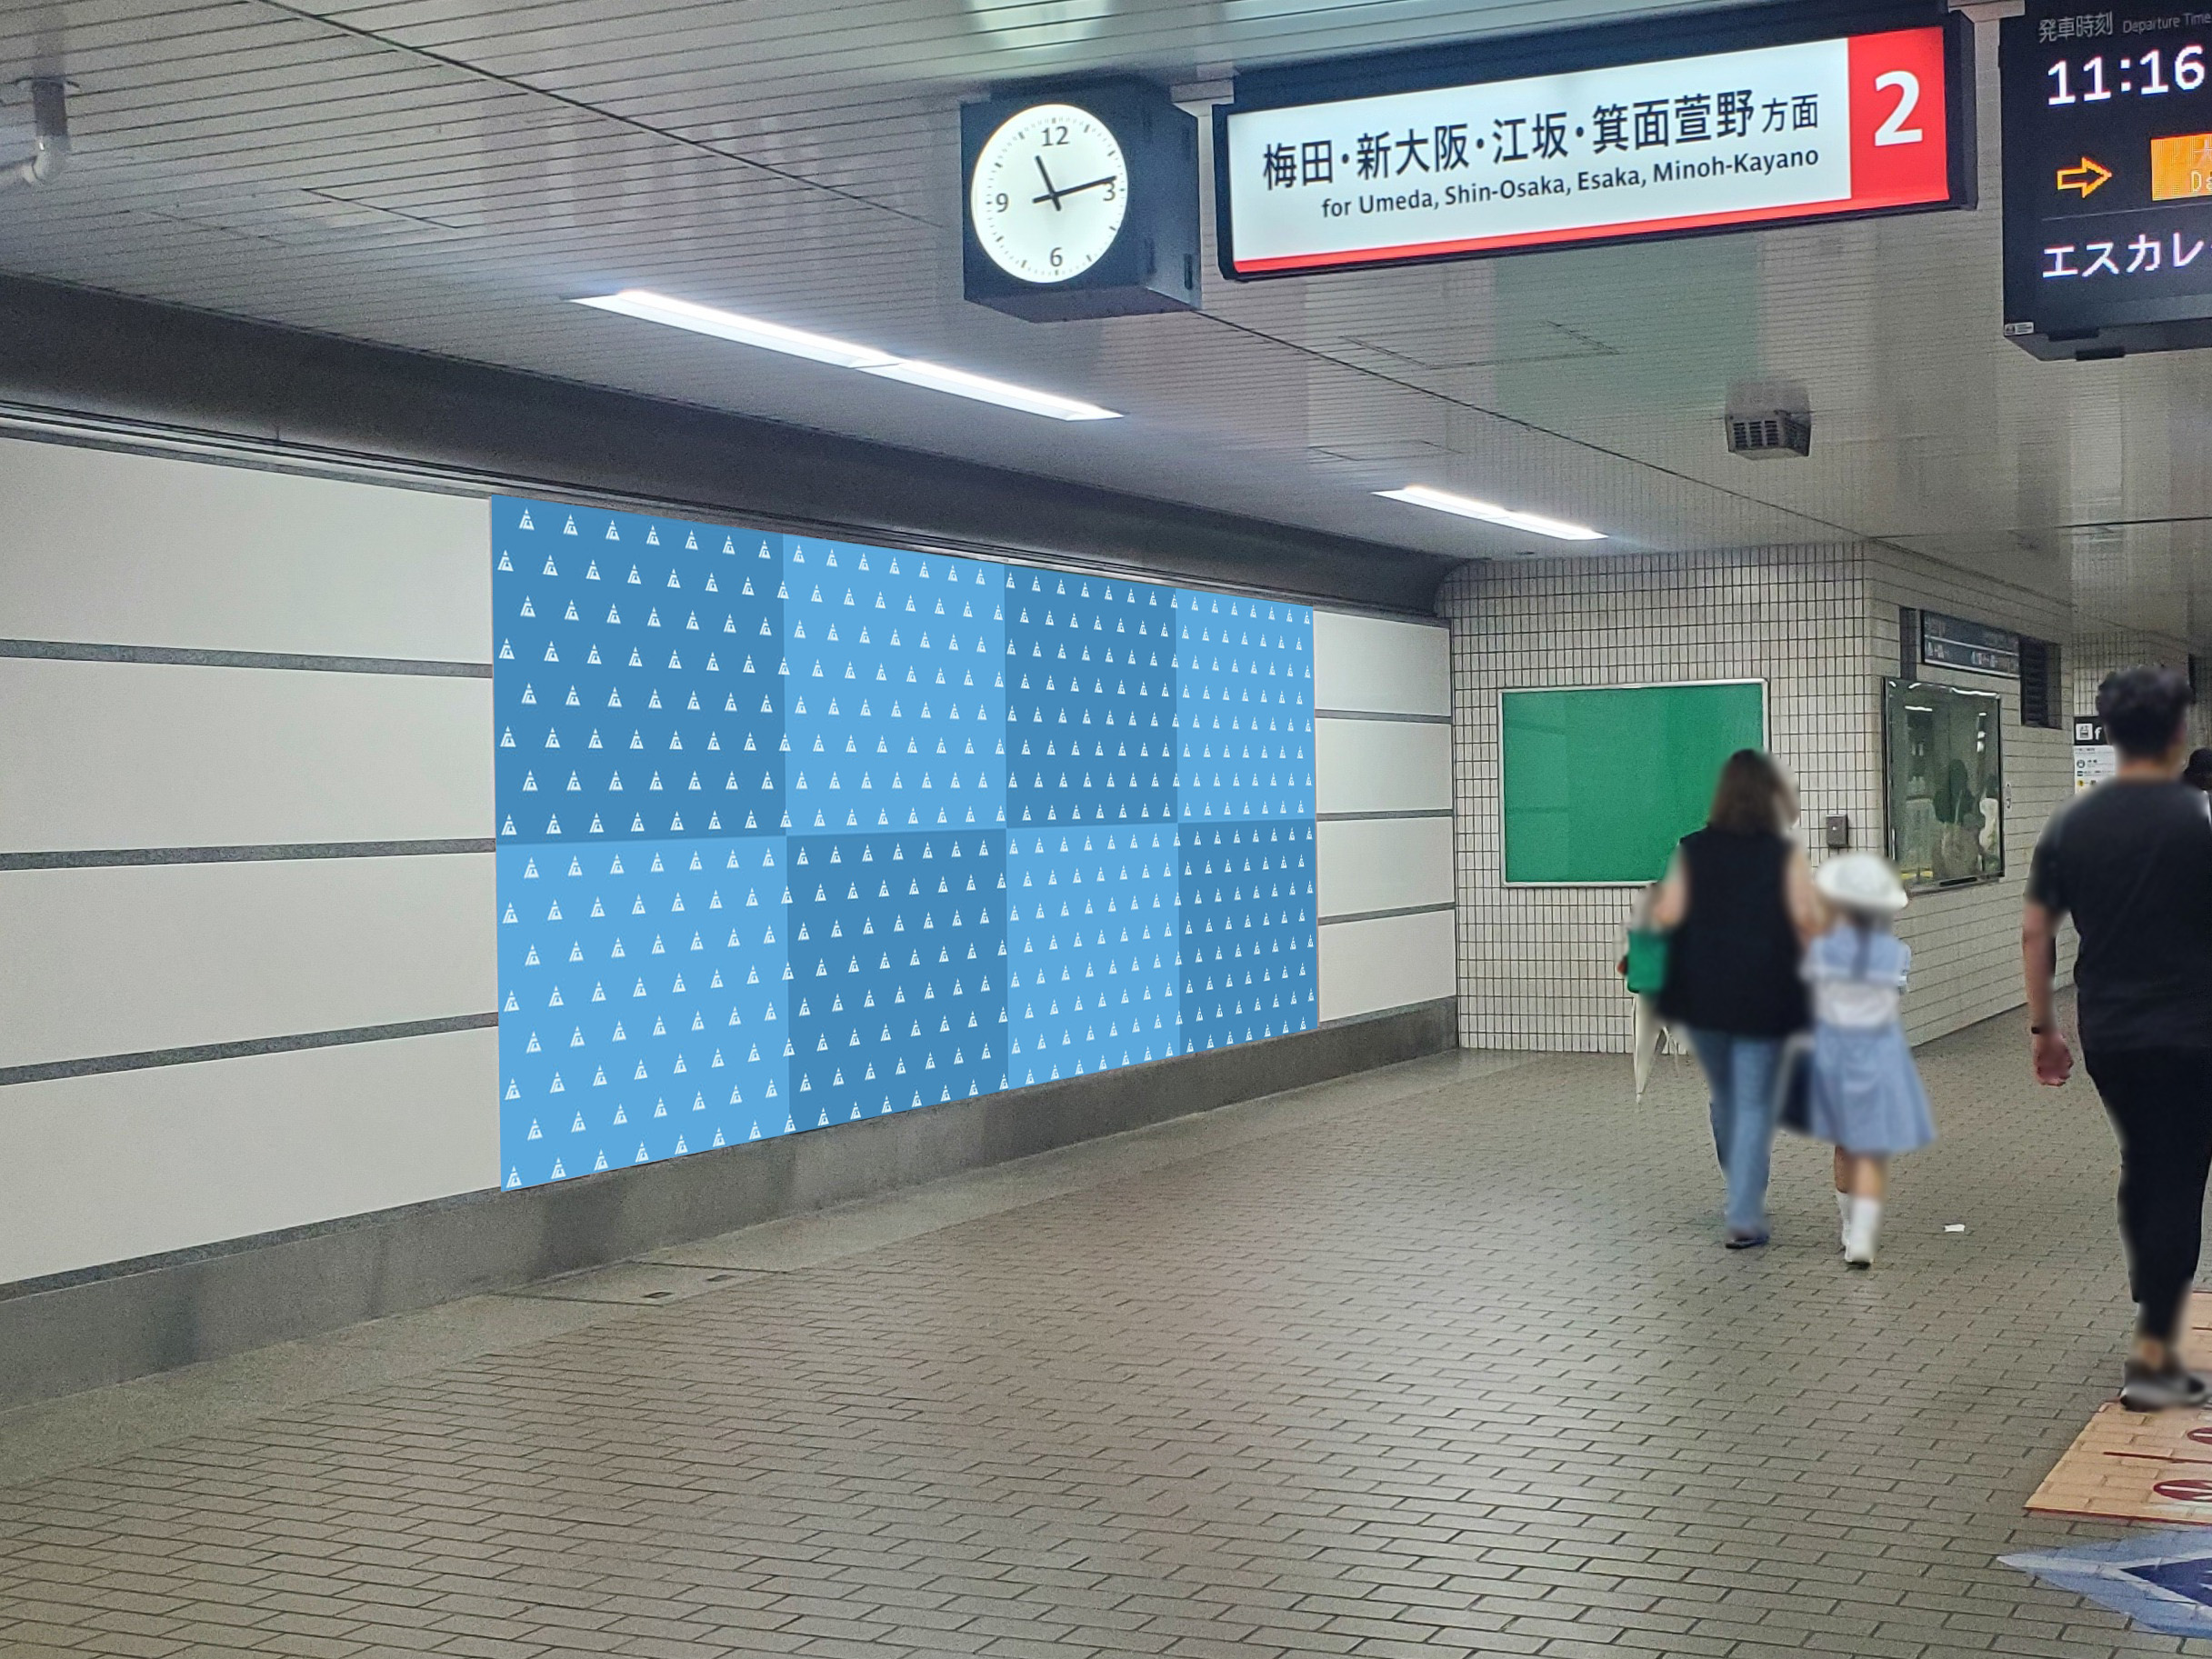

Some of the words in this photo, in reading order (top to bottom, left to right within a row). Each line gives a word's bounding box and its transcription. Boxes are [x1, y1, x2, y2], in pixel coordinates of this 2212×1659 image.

[2038, 11, 2113, 44] 発車時刻
[2122, 16, 2181, 35] Departure
[2182, 12, 2212, 26] Time
[2047, 45, 2206, 106] 11:16
[1874, 69, 1924, 147] 2
[1041, 125, 1071, 147] 12
[1102, 181, 1116, 202] 3
[1322, 197, 1353, 218] for
[1358, 188, 1440, 215] Umeda,
[1444, 175, 1572, 206] Shin-Osaka,
[1577, 165, 1647, 192] Esaka,
[1653, 147, 1819, 184] Minoh-Kayano
[996, 193, 1009, 214] 9
[1049, 246, 1064, 267] 6
[2042, 232, 2212, 279] エスカレ
